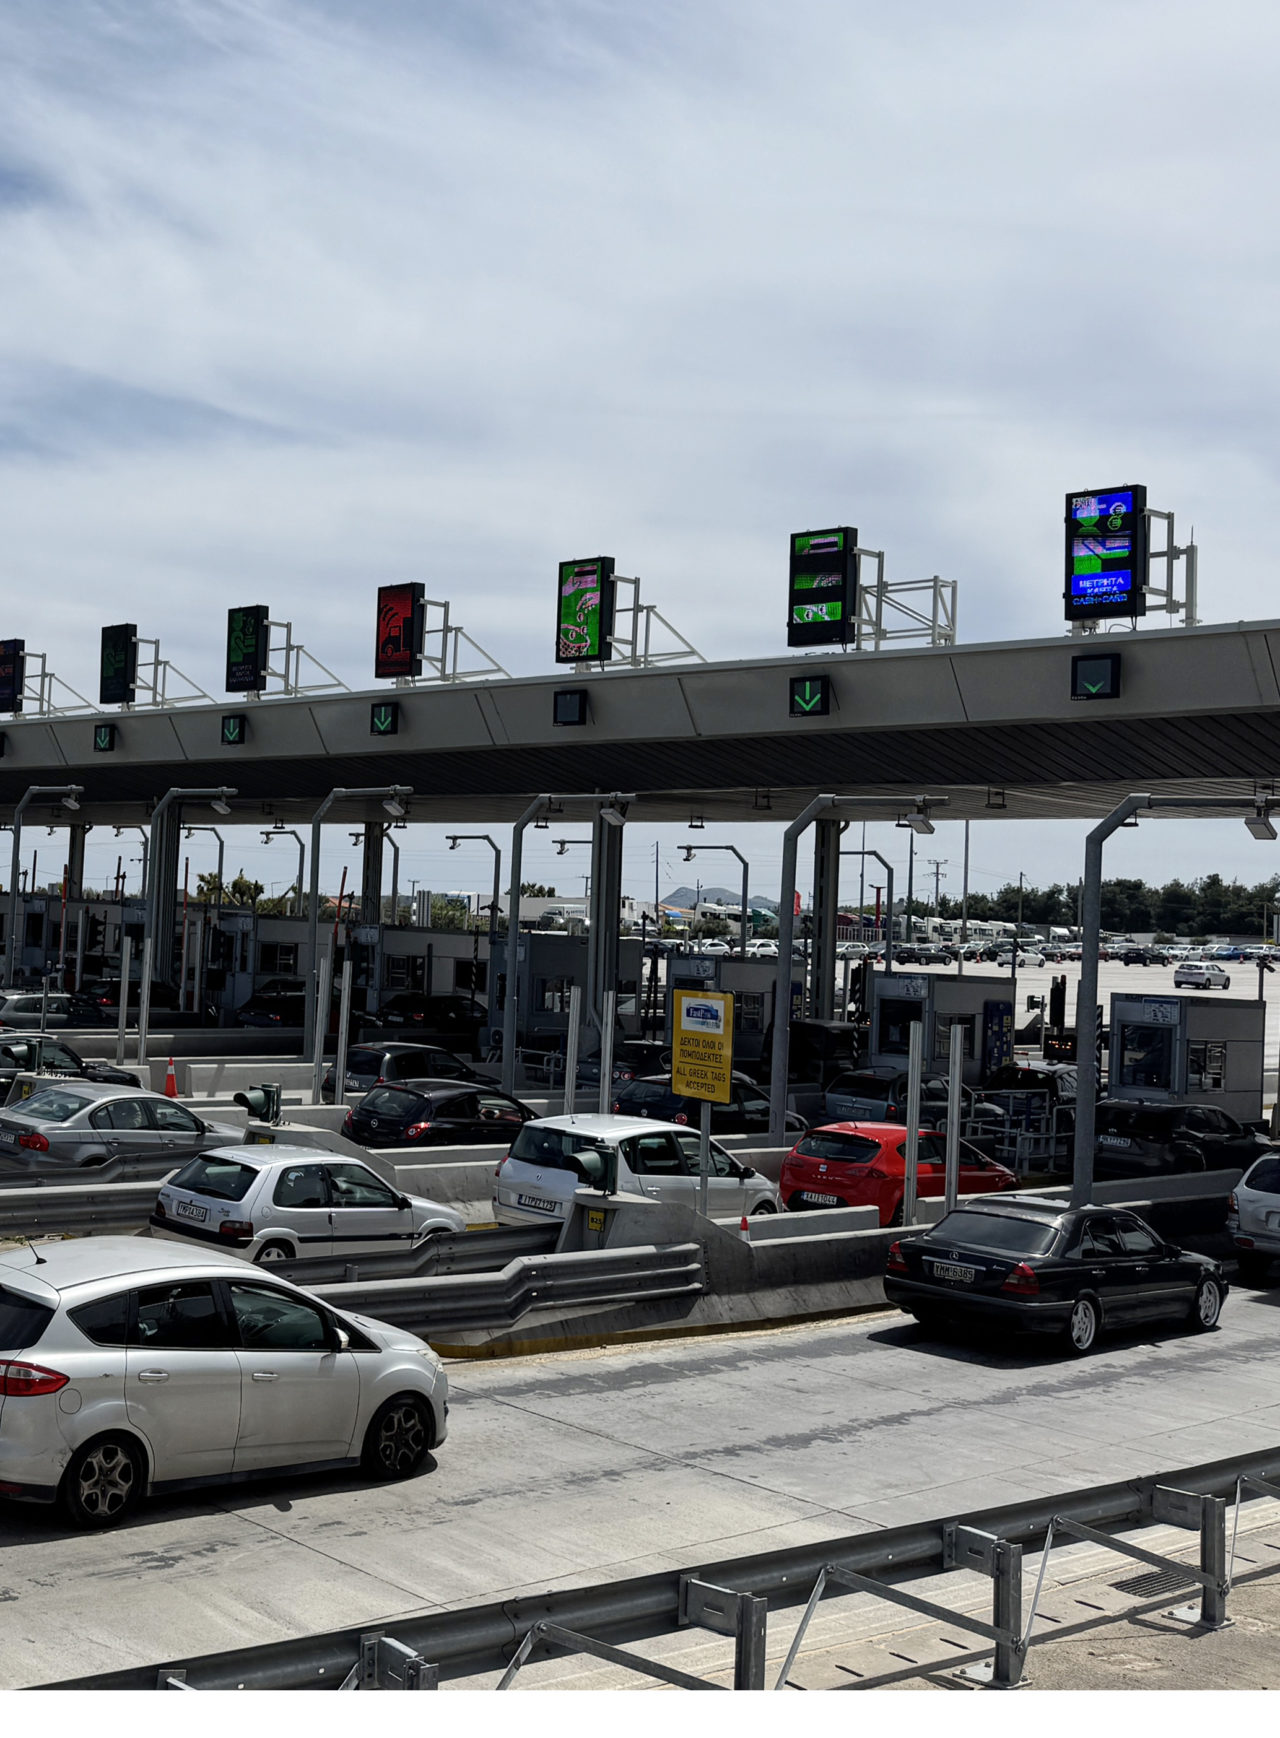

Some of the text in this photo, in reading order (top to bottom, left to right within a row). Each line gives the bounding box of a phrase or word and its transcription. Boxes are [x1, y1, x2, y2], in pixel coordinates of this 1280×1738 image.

[680, 1037, 724, 1051] ΔΕΚΤΟΙ ΟΛΟΙ ΟΙ
[679, 1048, 723, 1064] ΠΟΜΠΟΔΕΚΤΕΣ
[676, 1066, 726, 1082] ALL GREEK TAGS
[685, 1080, 716, 1094] ACCEPTED
